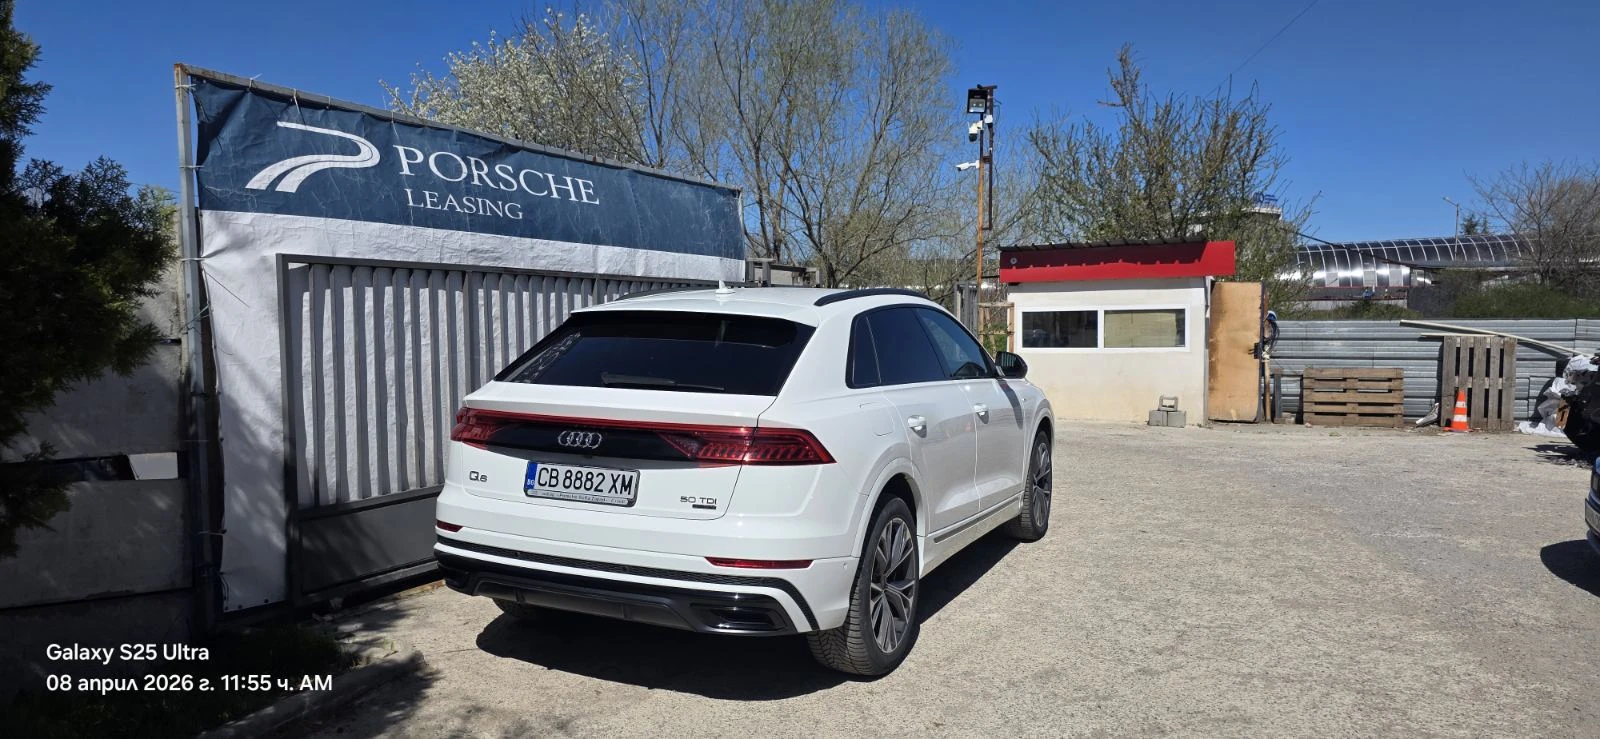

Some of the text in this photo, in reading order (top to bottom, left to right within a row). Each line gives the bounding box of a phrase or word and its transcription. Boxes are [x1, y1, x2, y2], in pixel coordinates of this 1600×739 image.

[393, 145, 600, 205] PORSCHE
[404, 188, 523, 220] LEASING
[469, 471, 488, 482] Q8
[538, 467, 633, 495] CB 8882 XM
